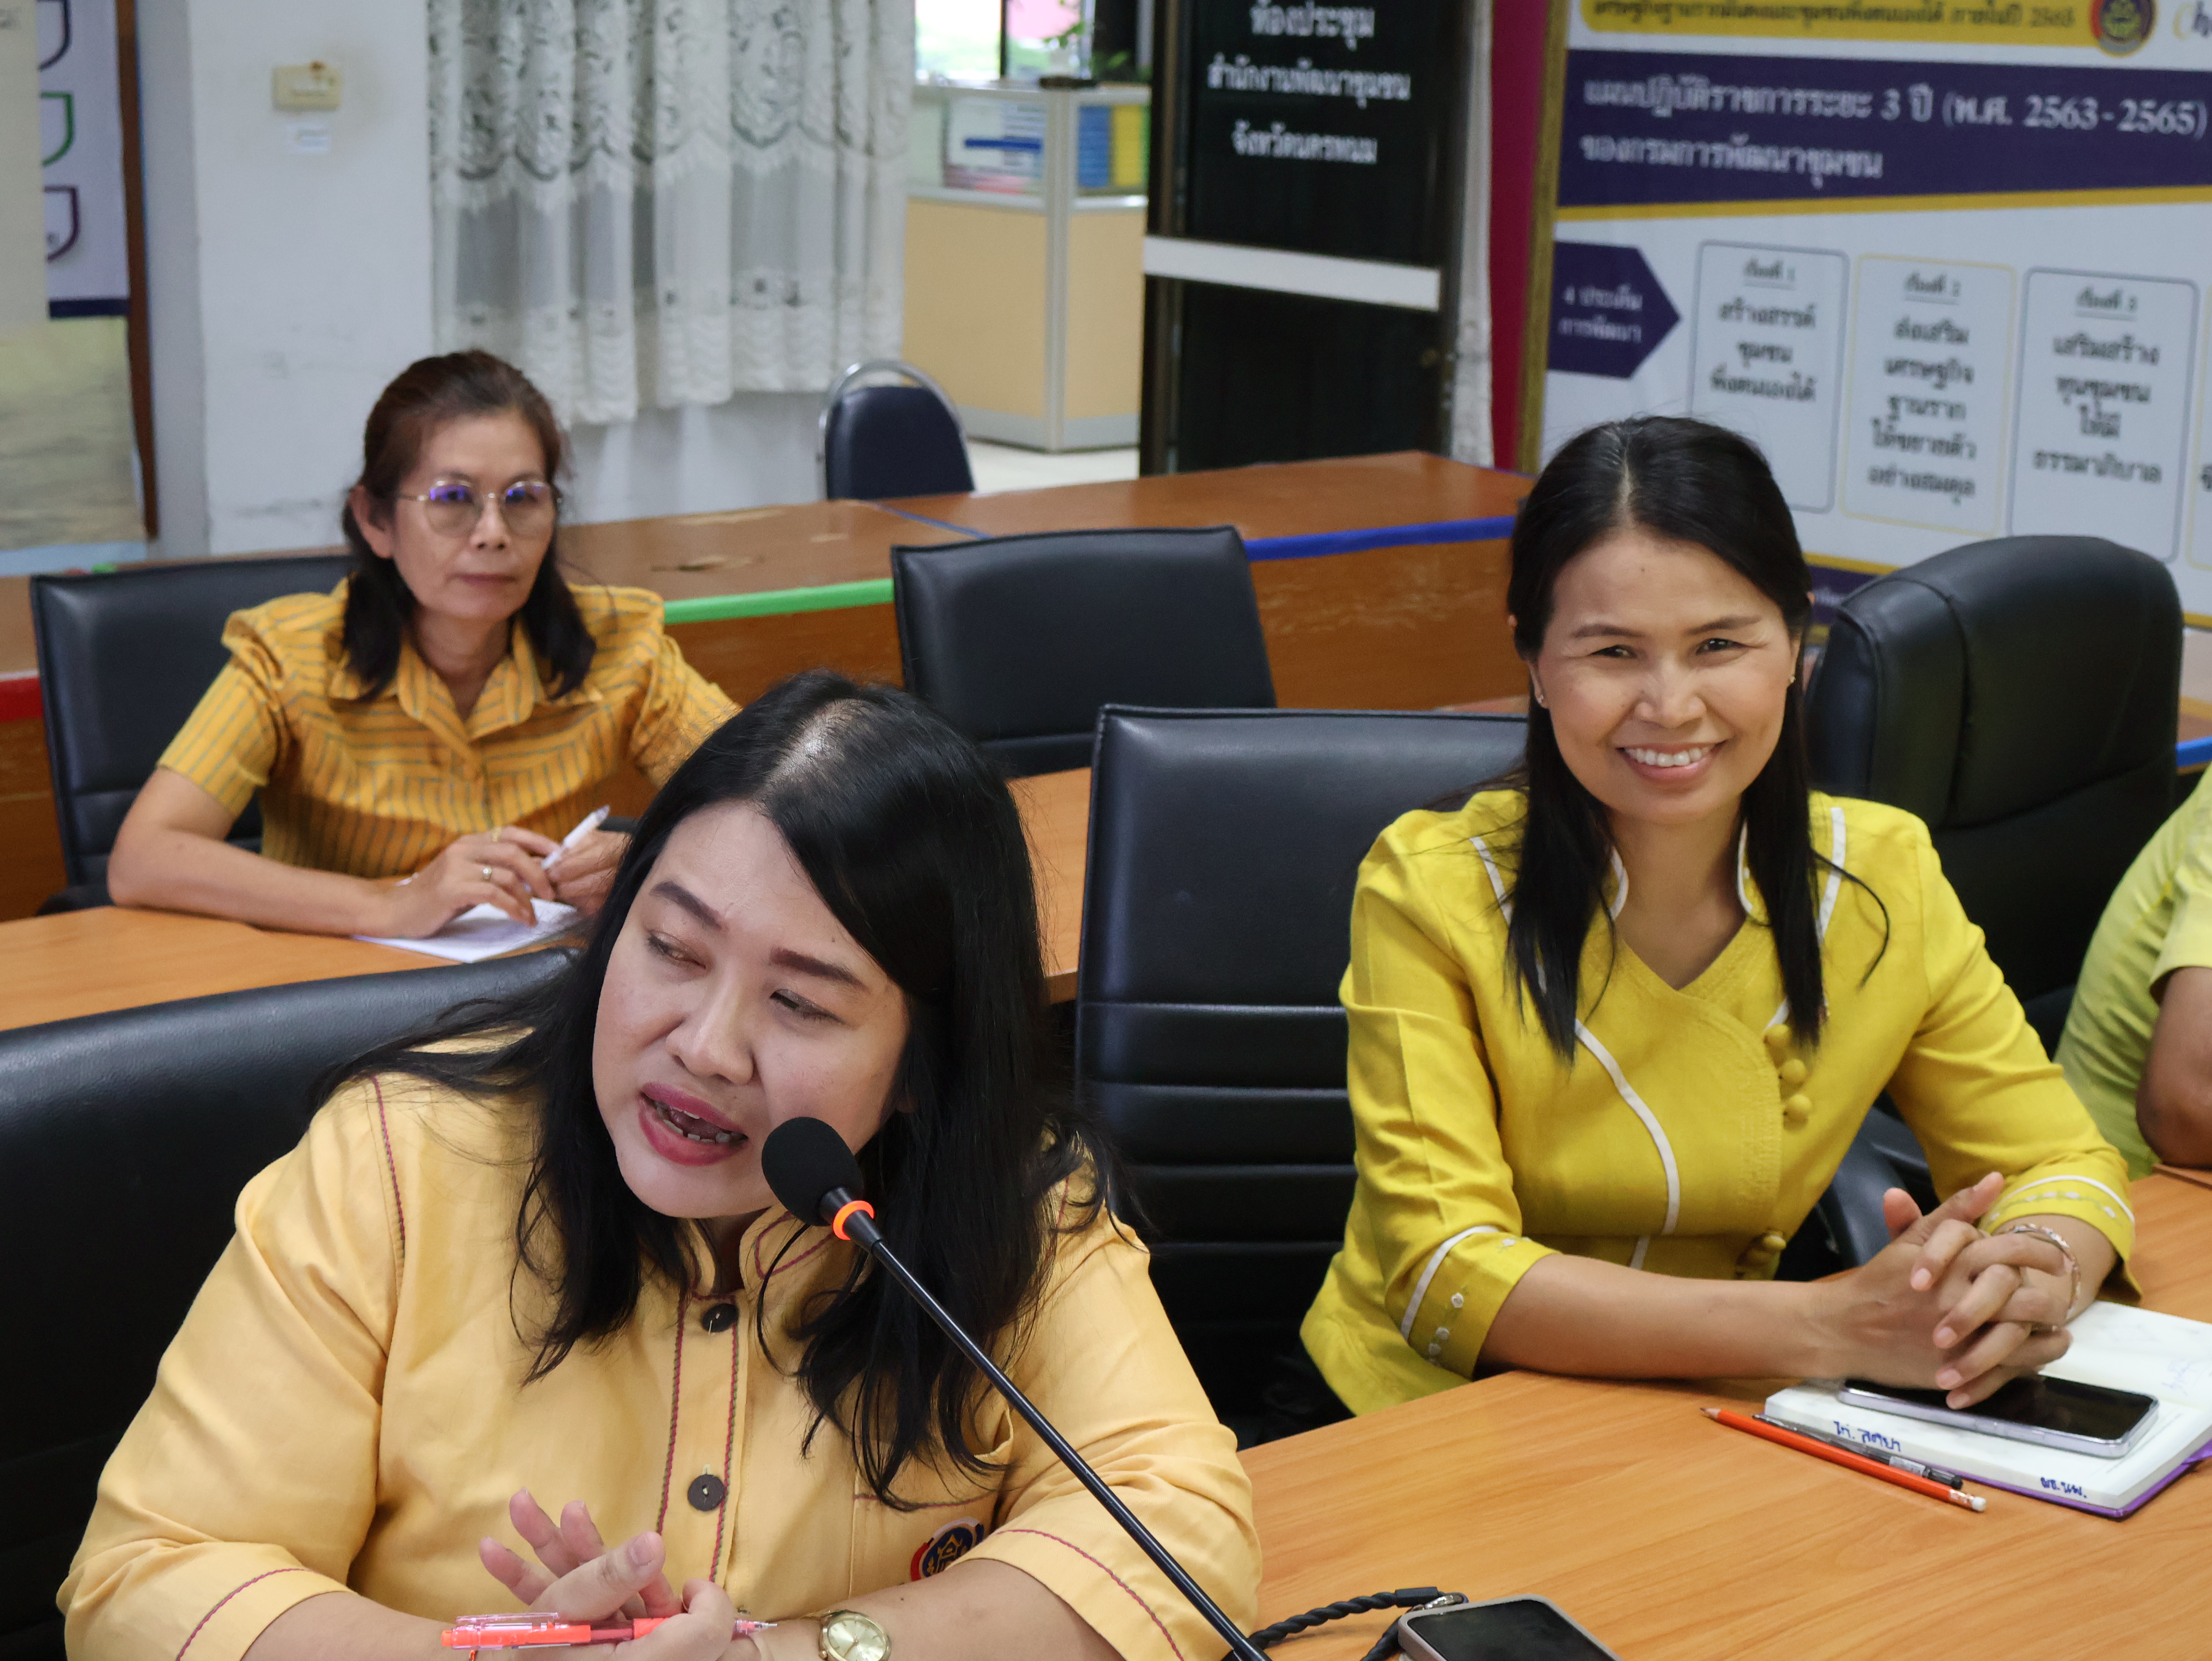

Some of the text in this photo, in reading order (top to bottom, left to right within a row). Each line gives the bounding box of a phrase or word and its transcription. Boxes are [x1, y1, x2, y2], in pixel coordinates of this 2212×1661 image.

[1583, 73, 1872, 118] แผนปฏิบัติราชการระยะ
[1881, 88, 1901, 121] 3
[1909, 82, 1934, 122] ปี
[1942, 91, 2013, 128] (พ.ศ.
[1580, 132, 1884, 188] ของกรมการพัฒนาชุมชน
